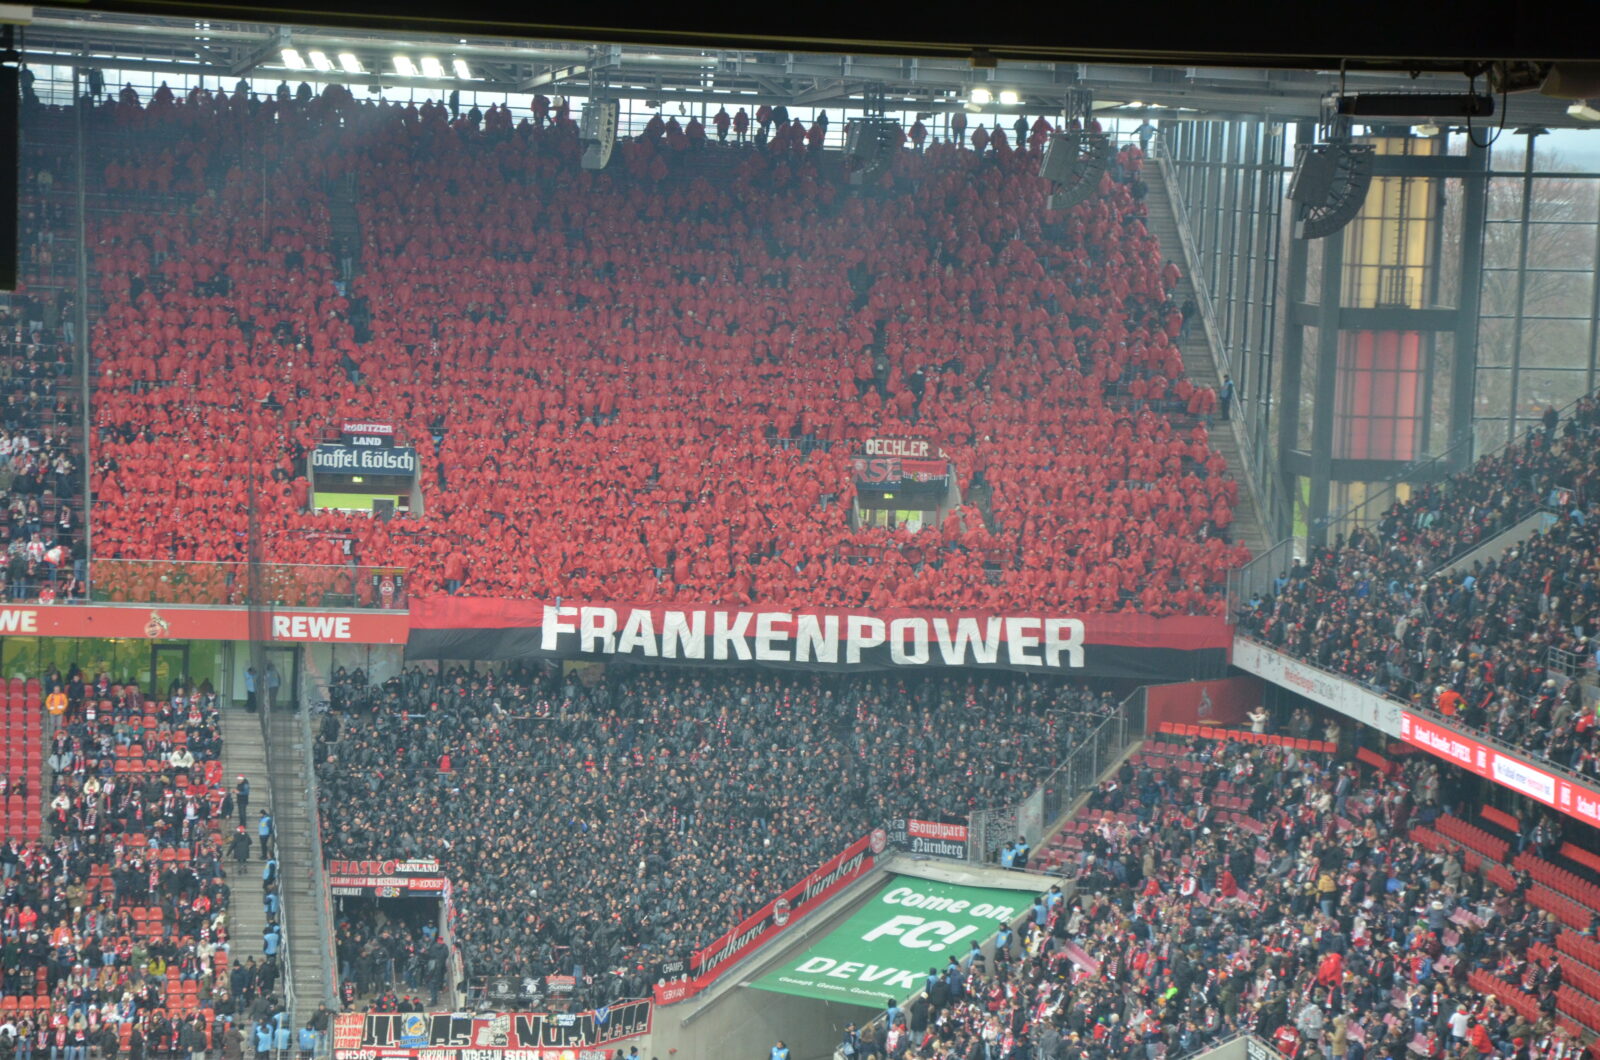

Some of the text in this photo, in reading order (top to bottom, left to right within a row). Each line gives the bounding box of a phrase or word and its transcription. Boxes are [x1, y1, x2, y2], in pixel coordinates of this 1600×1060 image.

[352, 436, 382, 446] LAND
[866, 439, 928, 457] OECHLER
[312, 449, 414, 471] Gaffel Kölsch
[272, 616, 351, 638] REWE
[541, 606, 1085, 668] FRANKENPOWER
[911, 837, 964, 858] Nürnberg
[330, 860, 395, 875] FIASKO
[395, 863, 439, 872] SEENLAND
[798, 853, 864, 906] Nürnberg
[332, 887, 362, 896] NEUMARKT
[882, 887, 971, 913] Come
[861, 915, 979, 952] FC!
[693, 920, 766, 982] Nordkurve
[662, 961, 684, 974] CHAMPS
[794, 956, 928, 989] DEVK
